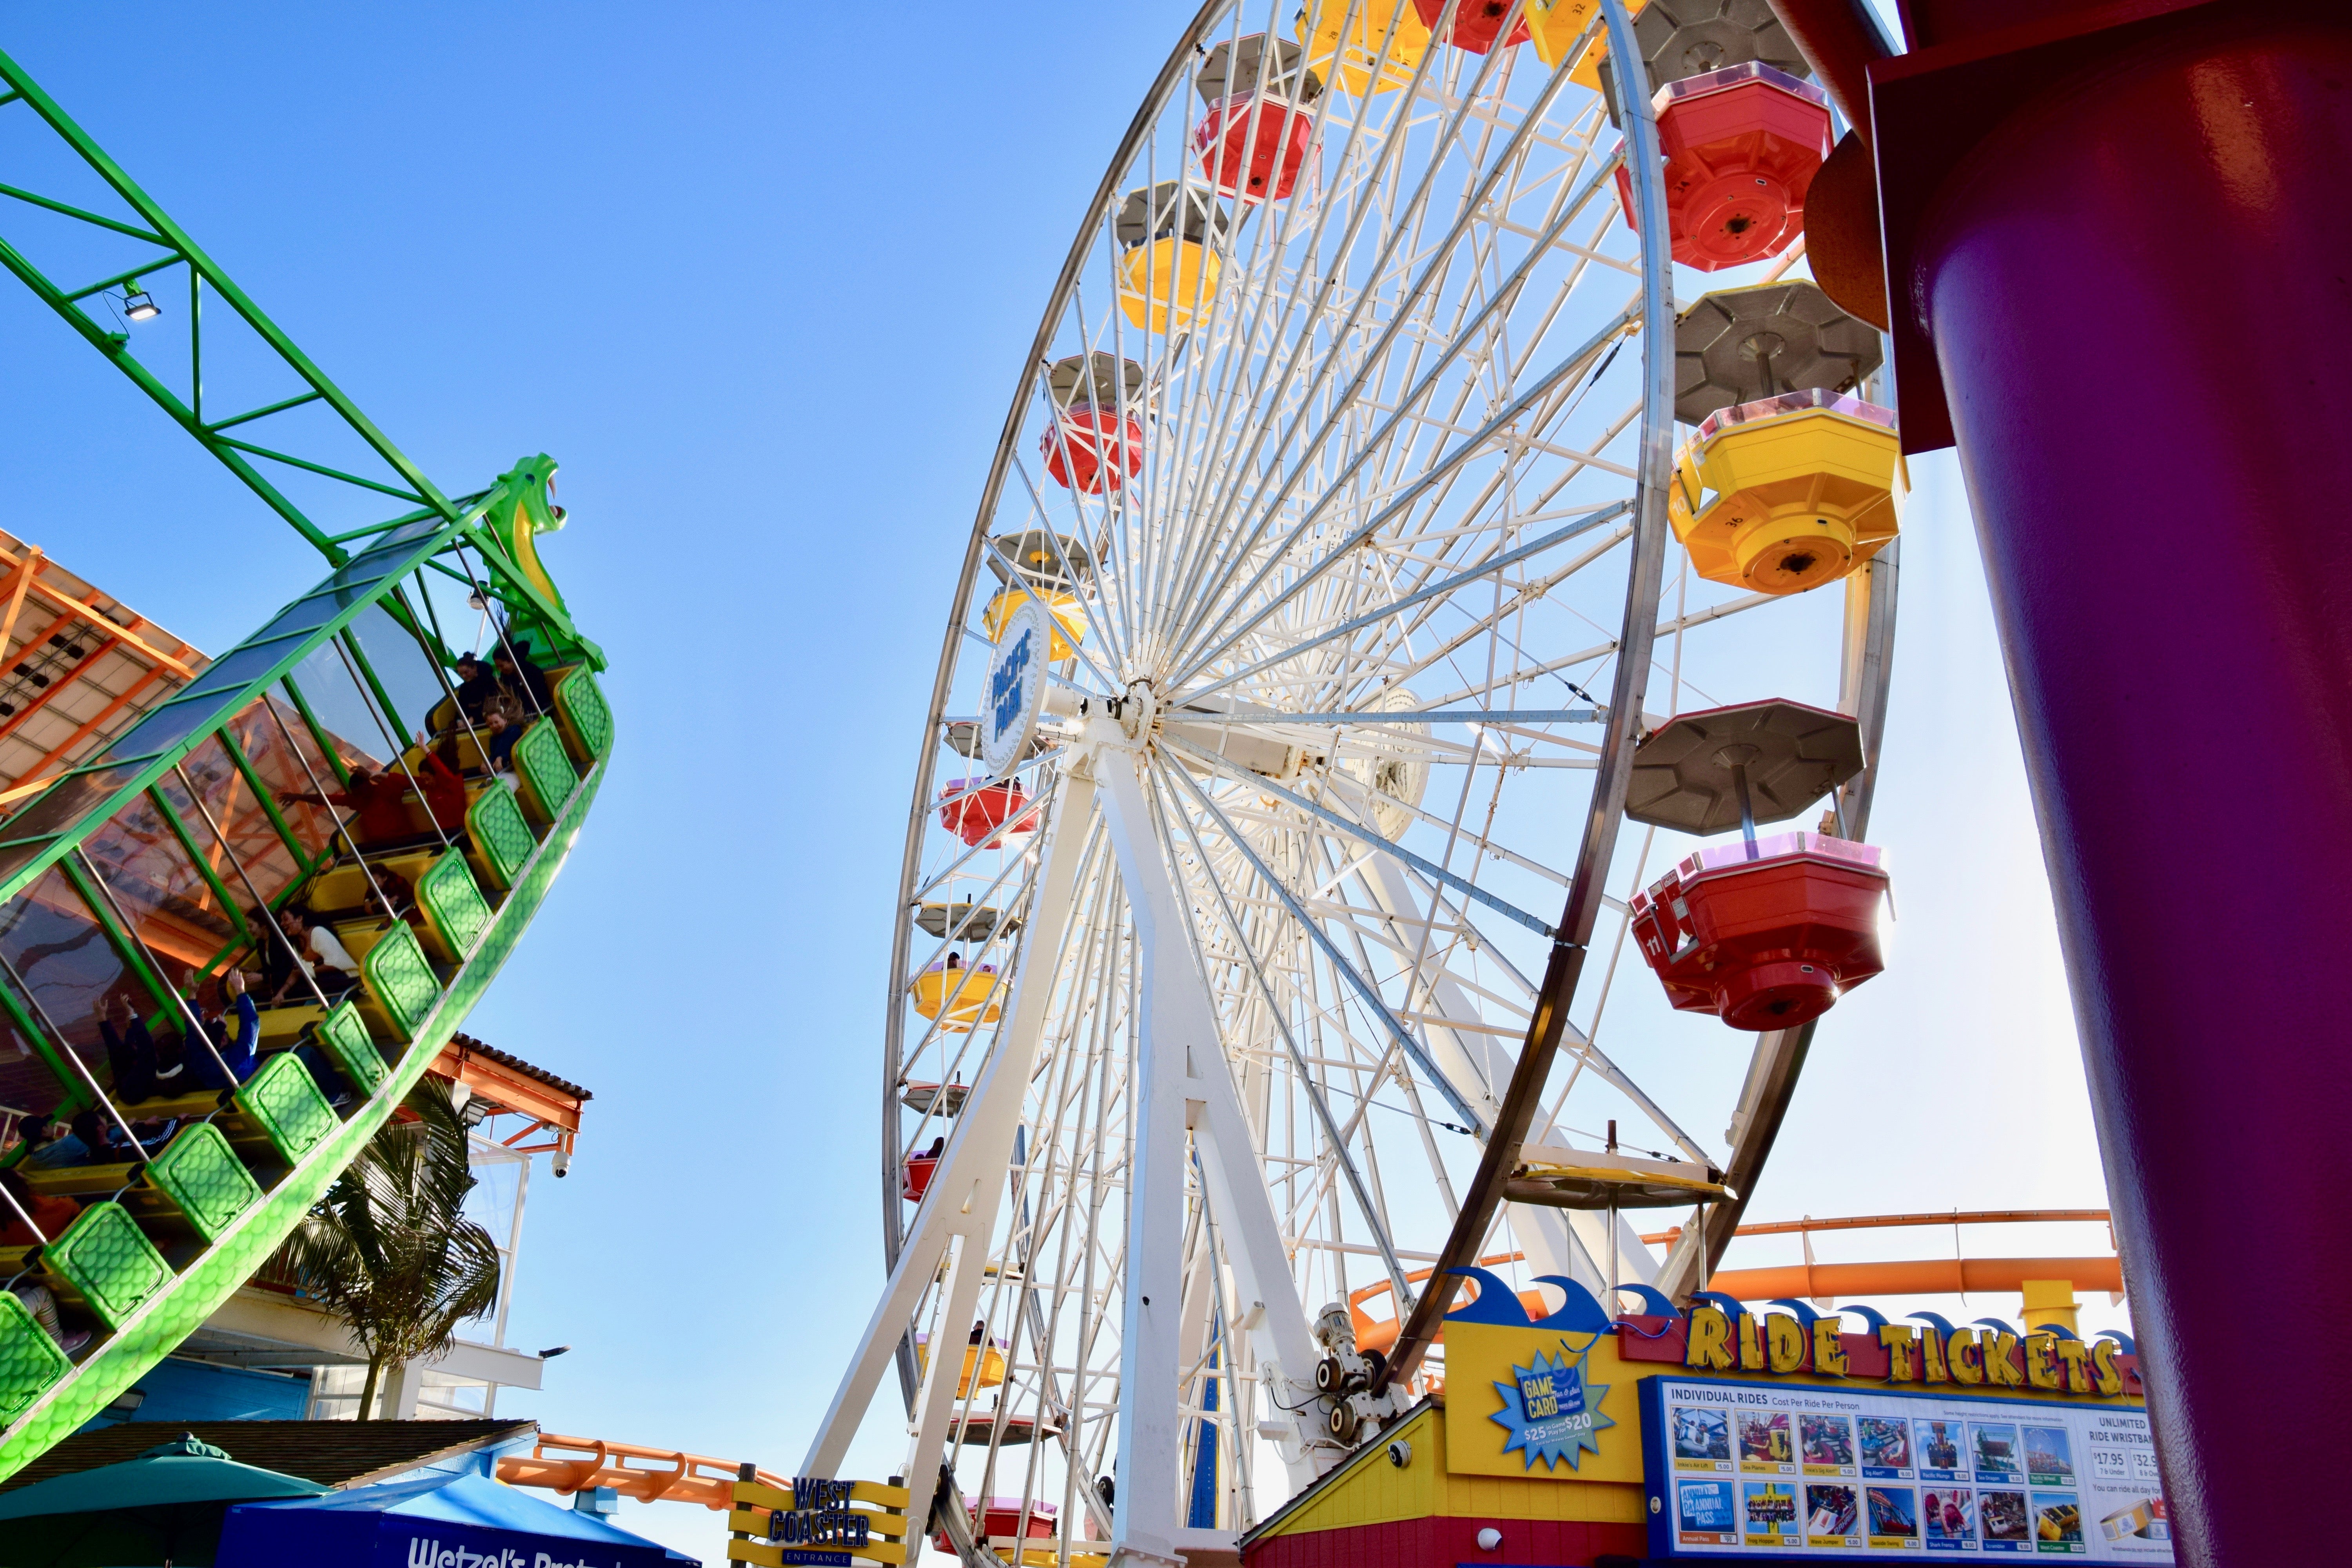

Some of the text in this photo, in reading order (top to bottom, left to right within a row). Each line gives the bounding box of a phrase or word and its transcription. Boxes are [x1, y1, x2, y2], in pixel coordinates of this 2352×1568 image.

[1572, 4, 1586, 15] 32
[1328, 31, 1338, 40] 28
[1672, 496, 1687, 516] 10
[1725, 517, 1743, 528] 36
[1663, 873, 1675, 883] PUSH
[1647, 936, 1661, 956] 11
[1685, 1304, 2123, 1398] RIDE TICKETS
[1524, 1376, 1556, 1398] GAME
[1570, 1387, 1581, 1396] Sun
[1671, 1388, 1735, 1403] INDIVIDUAL
[1737, 1392, 1768, 1405] RIDES
[1772, 1397, 1789, 1406] Cost
[1791, 1398, 1802, 1406] Per
[1822, 1400, 1833, 1408] Per
[1835, 1401, 1860, 1410] Person
[1528, 1396, 1558, 1418] CARD
[1565, 1412, 1592, 1430] $20
[2099, 1417, 2146, 1429] UNLIMITED
[1524, 1426, 1546, 1441] $25
[2089, 1431, 2109, 1441] RIDE
[2094, 1453, 2124, 1465] $17.95
[2133, 1454, 2156, 1467] $32.9
[792, 1476, 857, 1512] WEST
[2118, 1485, 2131, 1493] ride
[2140, 1486, 2151, 1495] day
[1695, 1497, 1724, 1510] ANNUAL
[1696, 1511, 1714, 1524] PASS
[769, 1510, 870, 1547] COASTER
[786, 1552, 848, 1563] ENTRANCE
